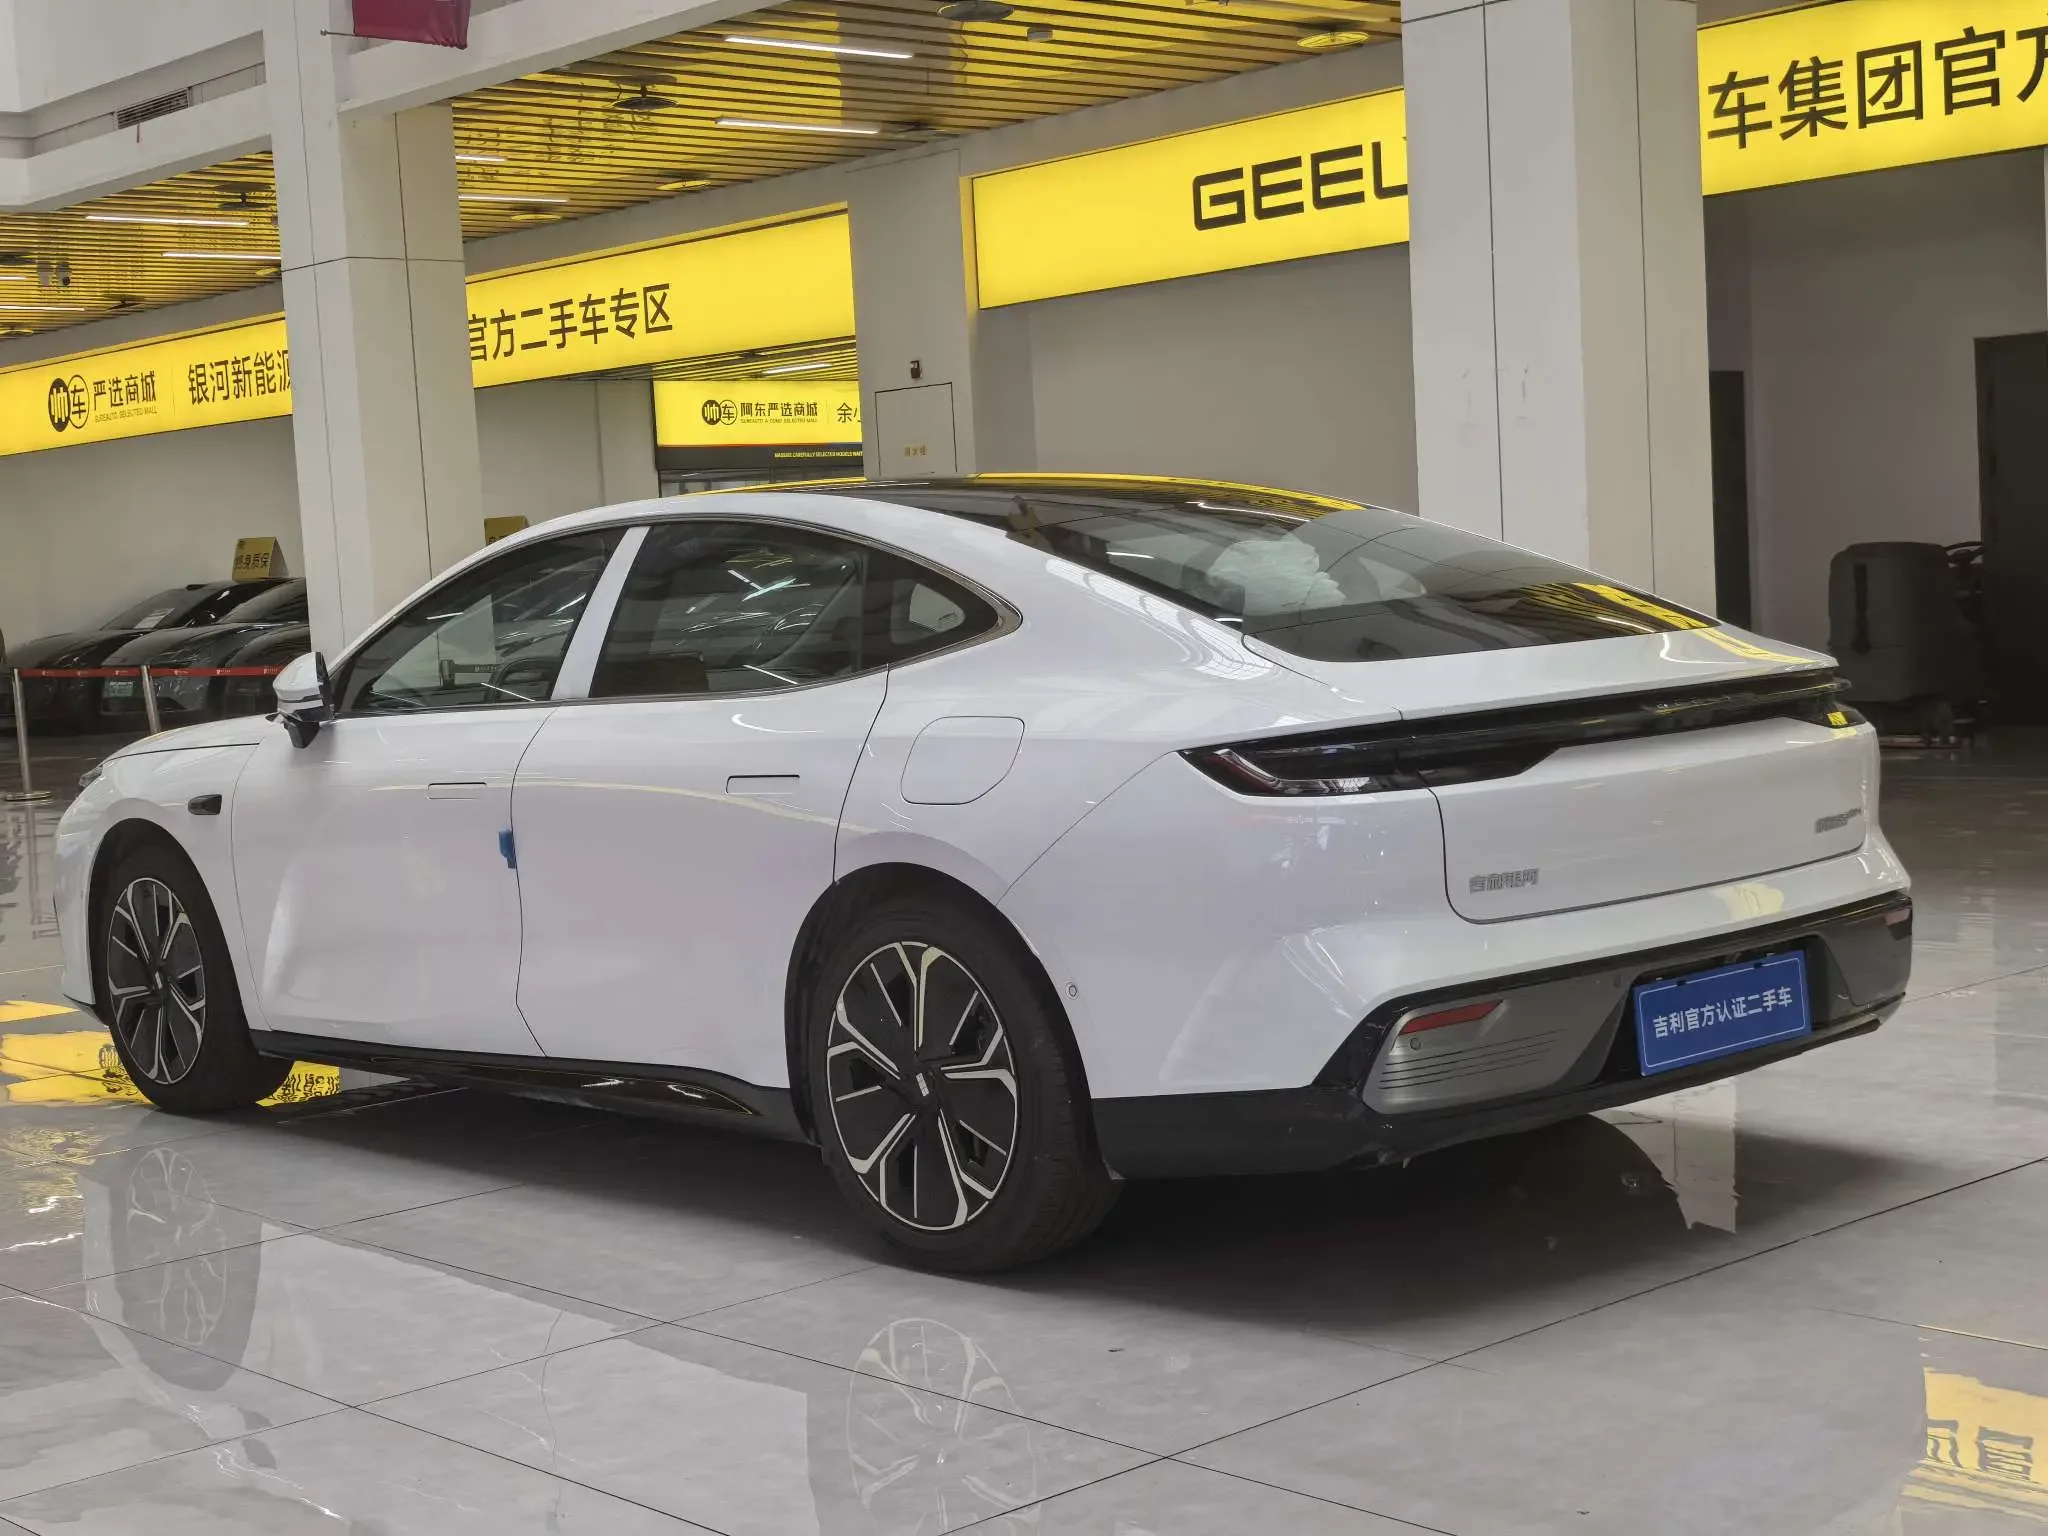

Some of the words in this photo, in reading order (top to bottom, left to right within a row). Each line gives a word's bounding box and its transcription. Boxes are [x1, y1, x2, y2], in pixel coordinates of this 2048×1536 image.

[1193, 137, 1408, 231] GEEL
[468, 283, 673, 362] 官方二手车专区
[93, 371, 156, 411] 严选商城
[740, 402, 818, 417] 阿东严选商城
[1653, 987, 1793, 1038] 吉利官方认证二手车
